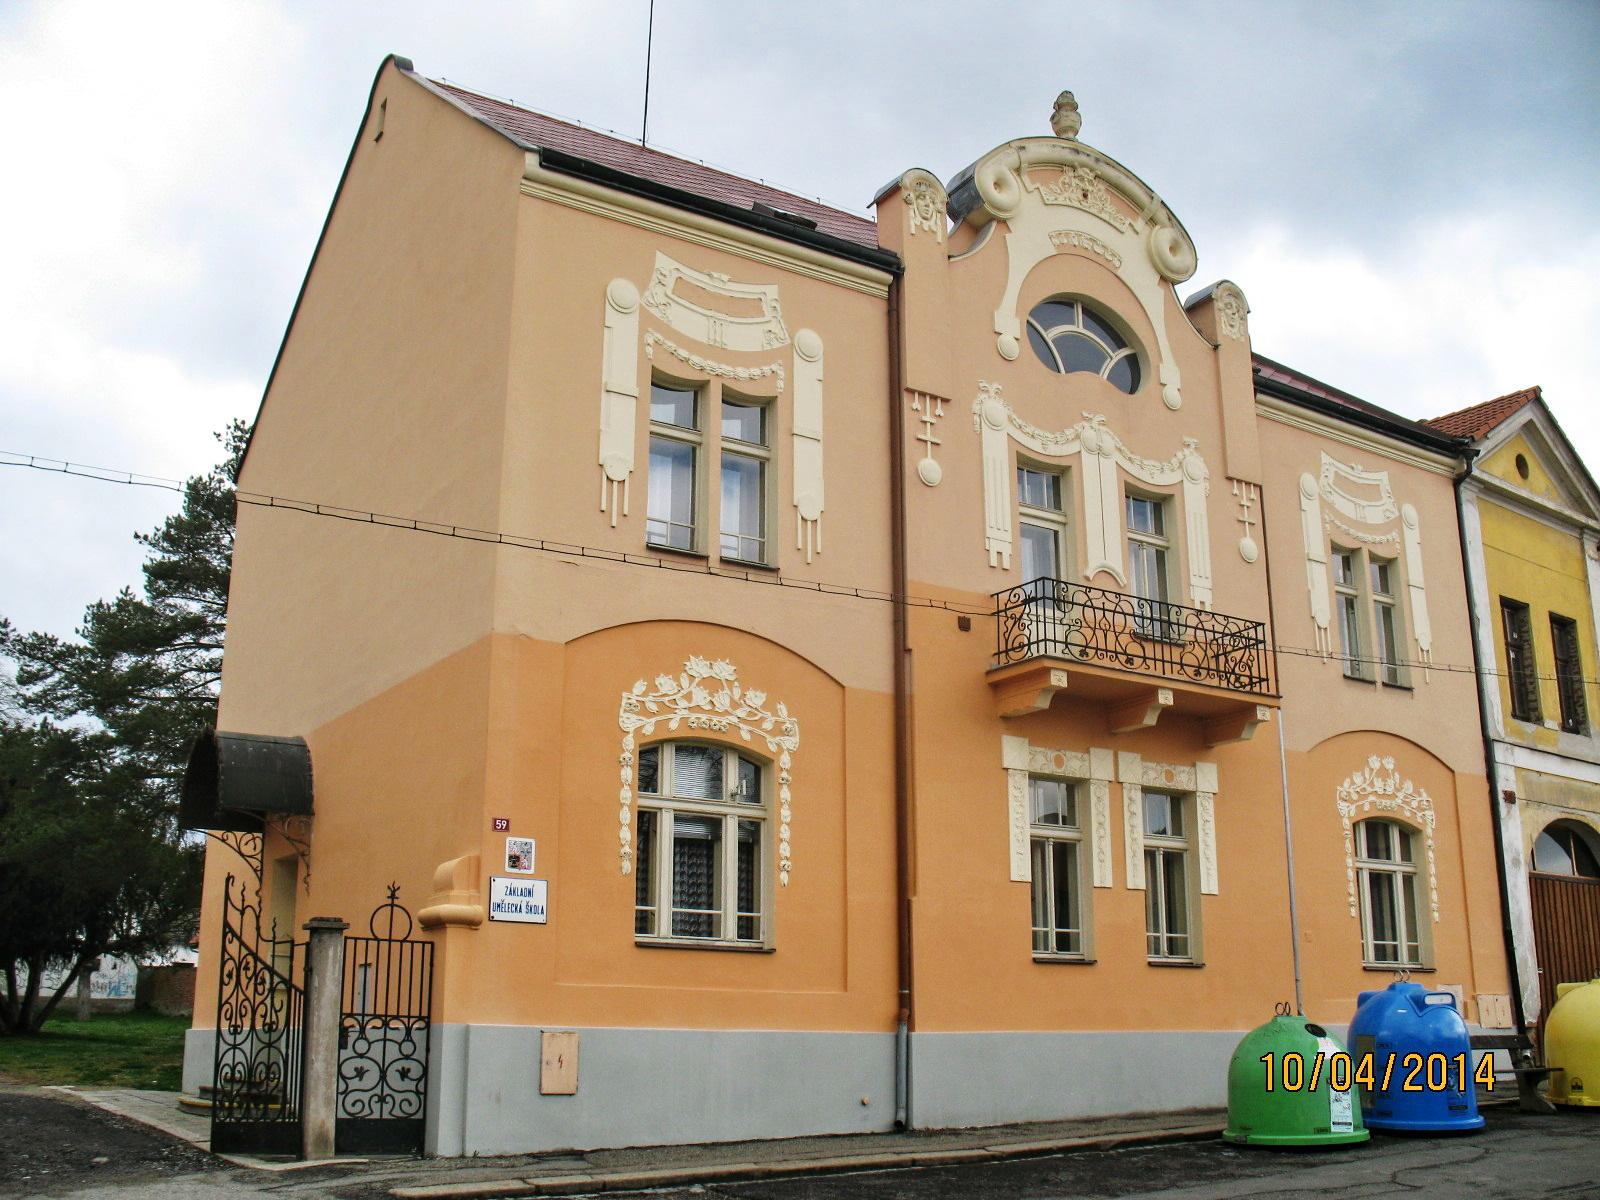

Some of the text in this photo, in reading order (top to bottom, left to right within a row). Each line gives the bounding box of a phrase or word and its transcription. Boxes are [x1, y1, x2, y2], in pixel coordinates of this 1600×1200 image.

[495, 819, 507, 830] 59
[504, 883, 534, 898] ZÁKLADNÍ
[492, 899, 545, 916] UMĚLECKÁ ŠKOLA
